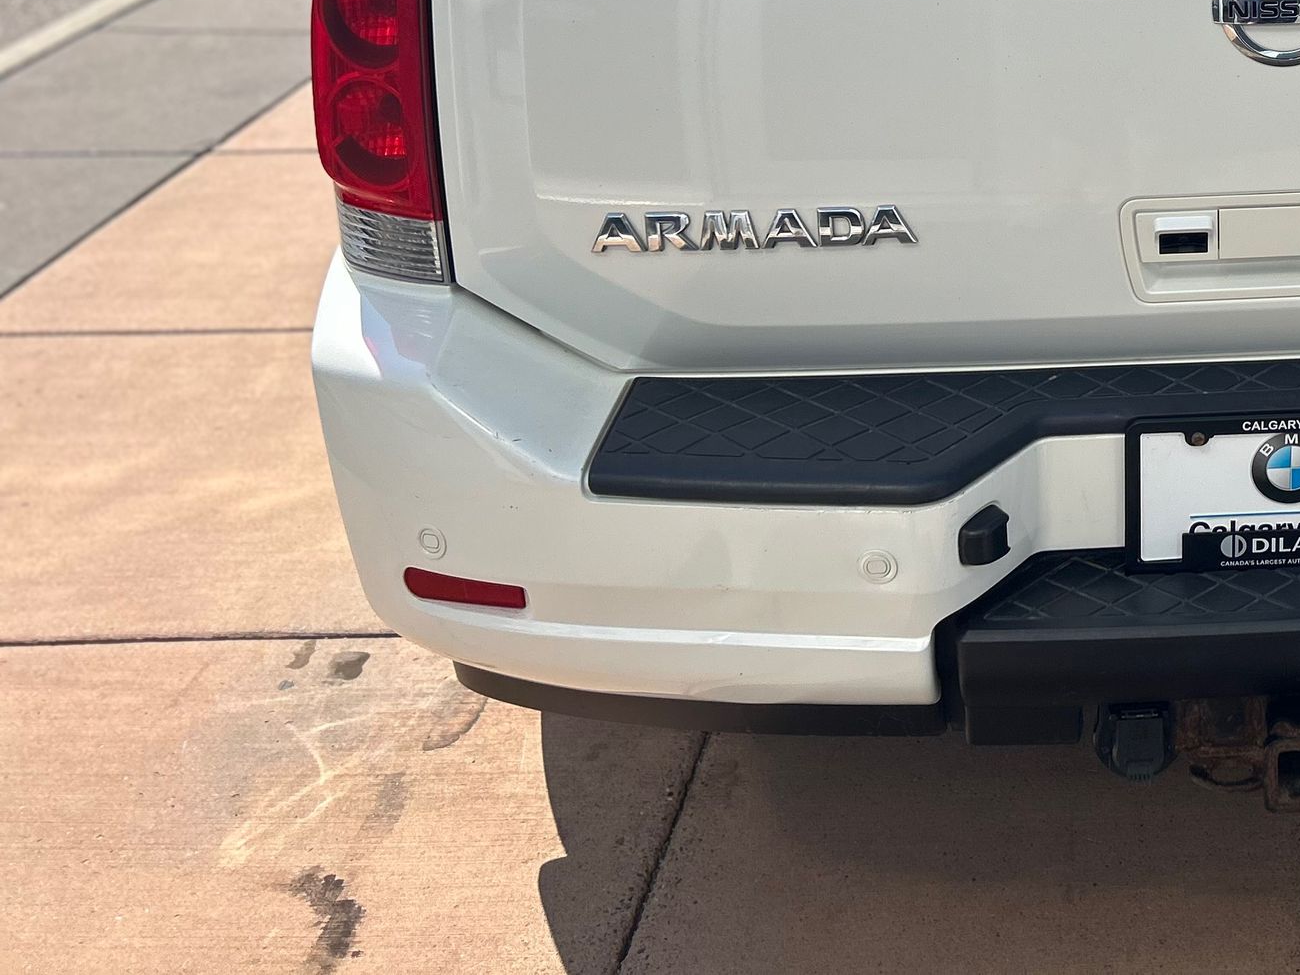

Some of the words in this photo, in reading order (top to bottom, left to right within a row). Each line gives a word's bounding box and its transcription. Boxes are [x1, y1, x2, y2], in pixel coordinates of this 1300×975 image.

[591, 204, 919, 253] ARMADA
[1220, 559, 1255, 567] CANADA'S
[1256, 558, 1286, 566] LARGEST
